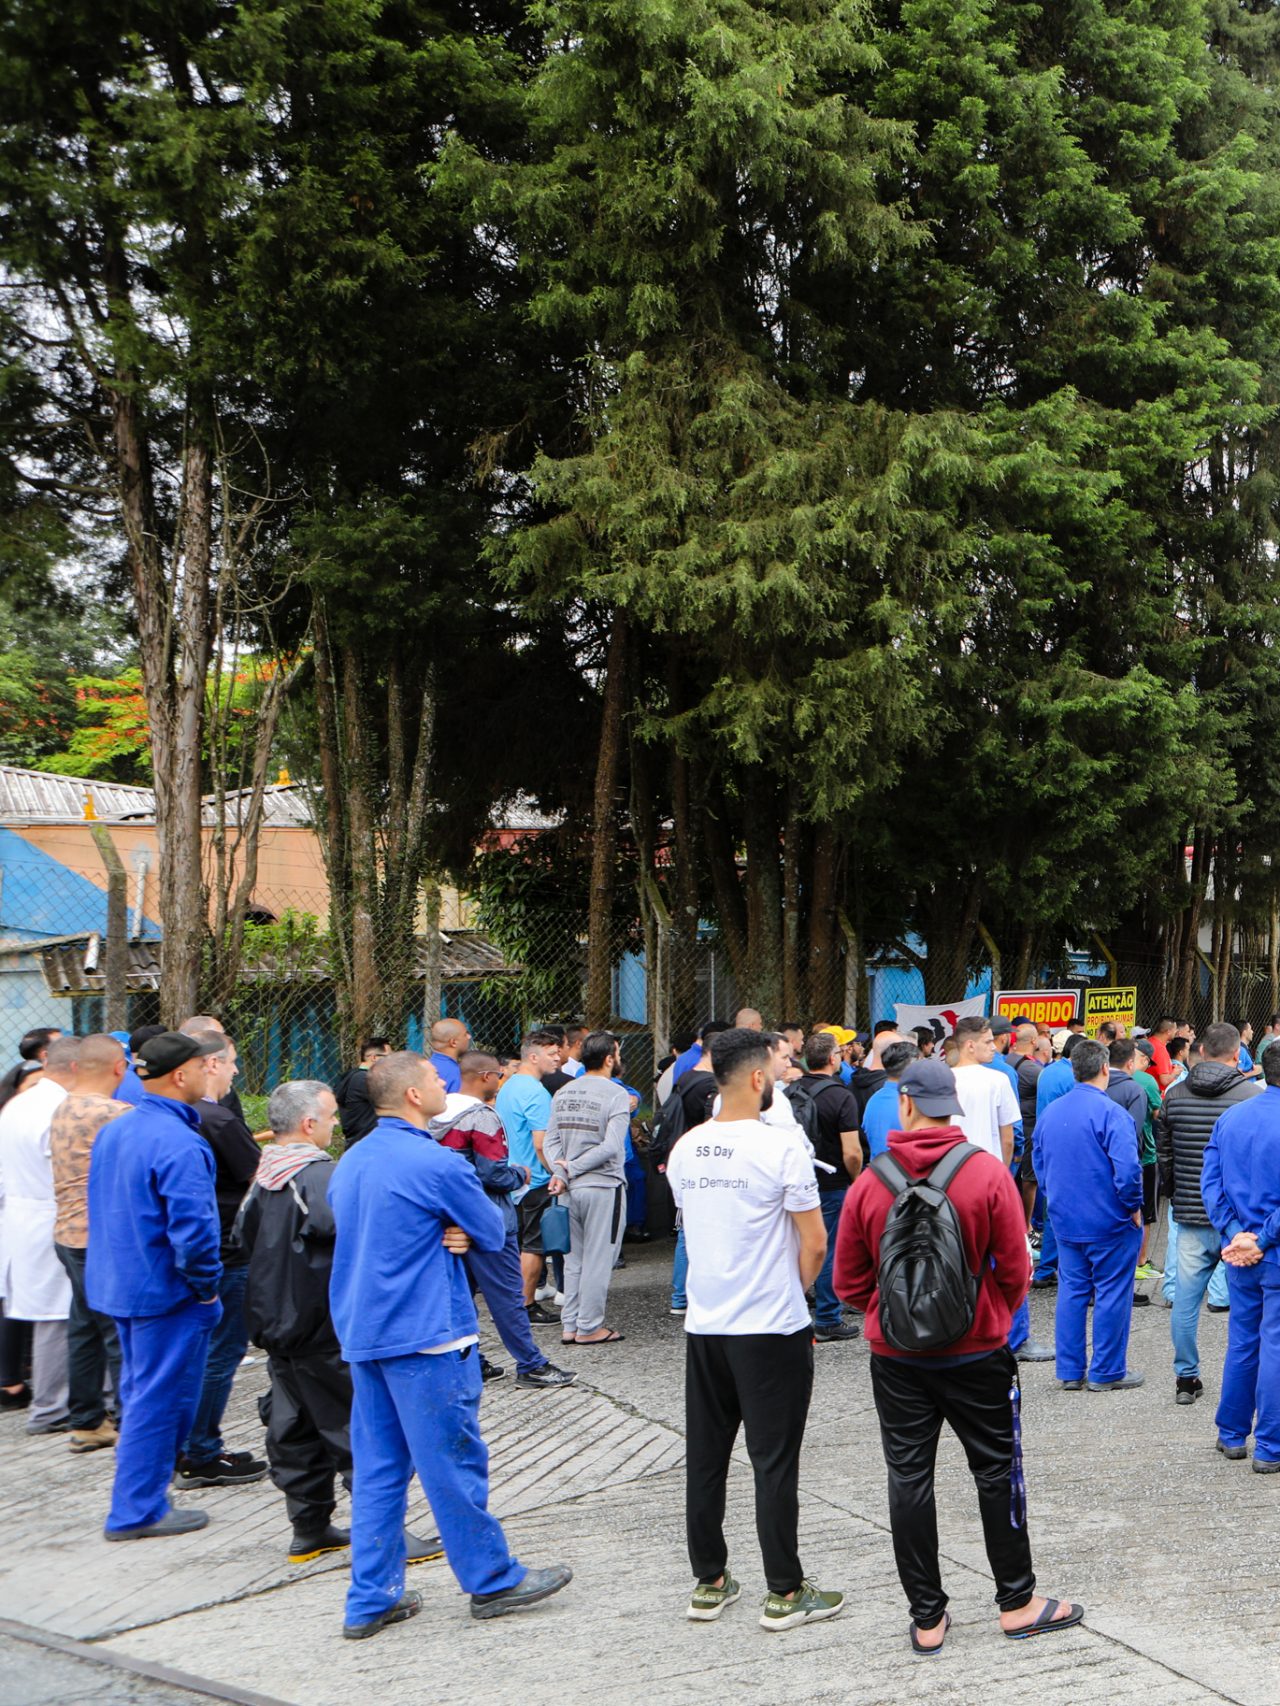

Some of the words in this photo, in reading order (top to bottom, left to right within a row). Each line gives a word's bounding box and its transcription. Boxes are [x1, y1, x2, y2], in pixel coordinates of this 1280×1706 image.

[1088, 992, 1133, 1012] ATENÇÃO
[1000, 1001, 1072, 1023] PROIBIDO
[696, 1146, 710, 1157] 5S
[713, 1146, 734, 1159] Day
[699, 1177, 749, 1189] Demarchi
